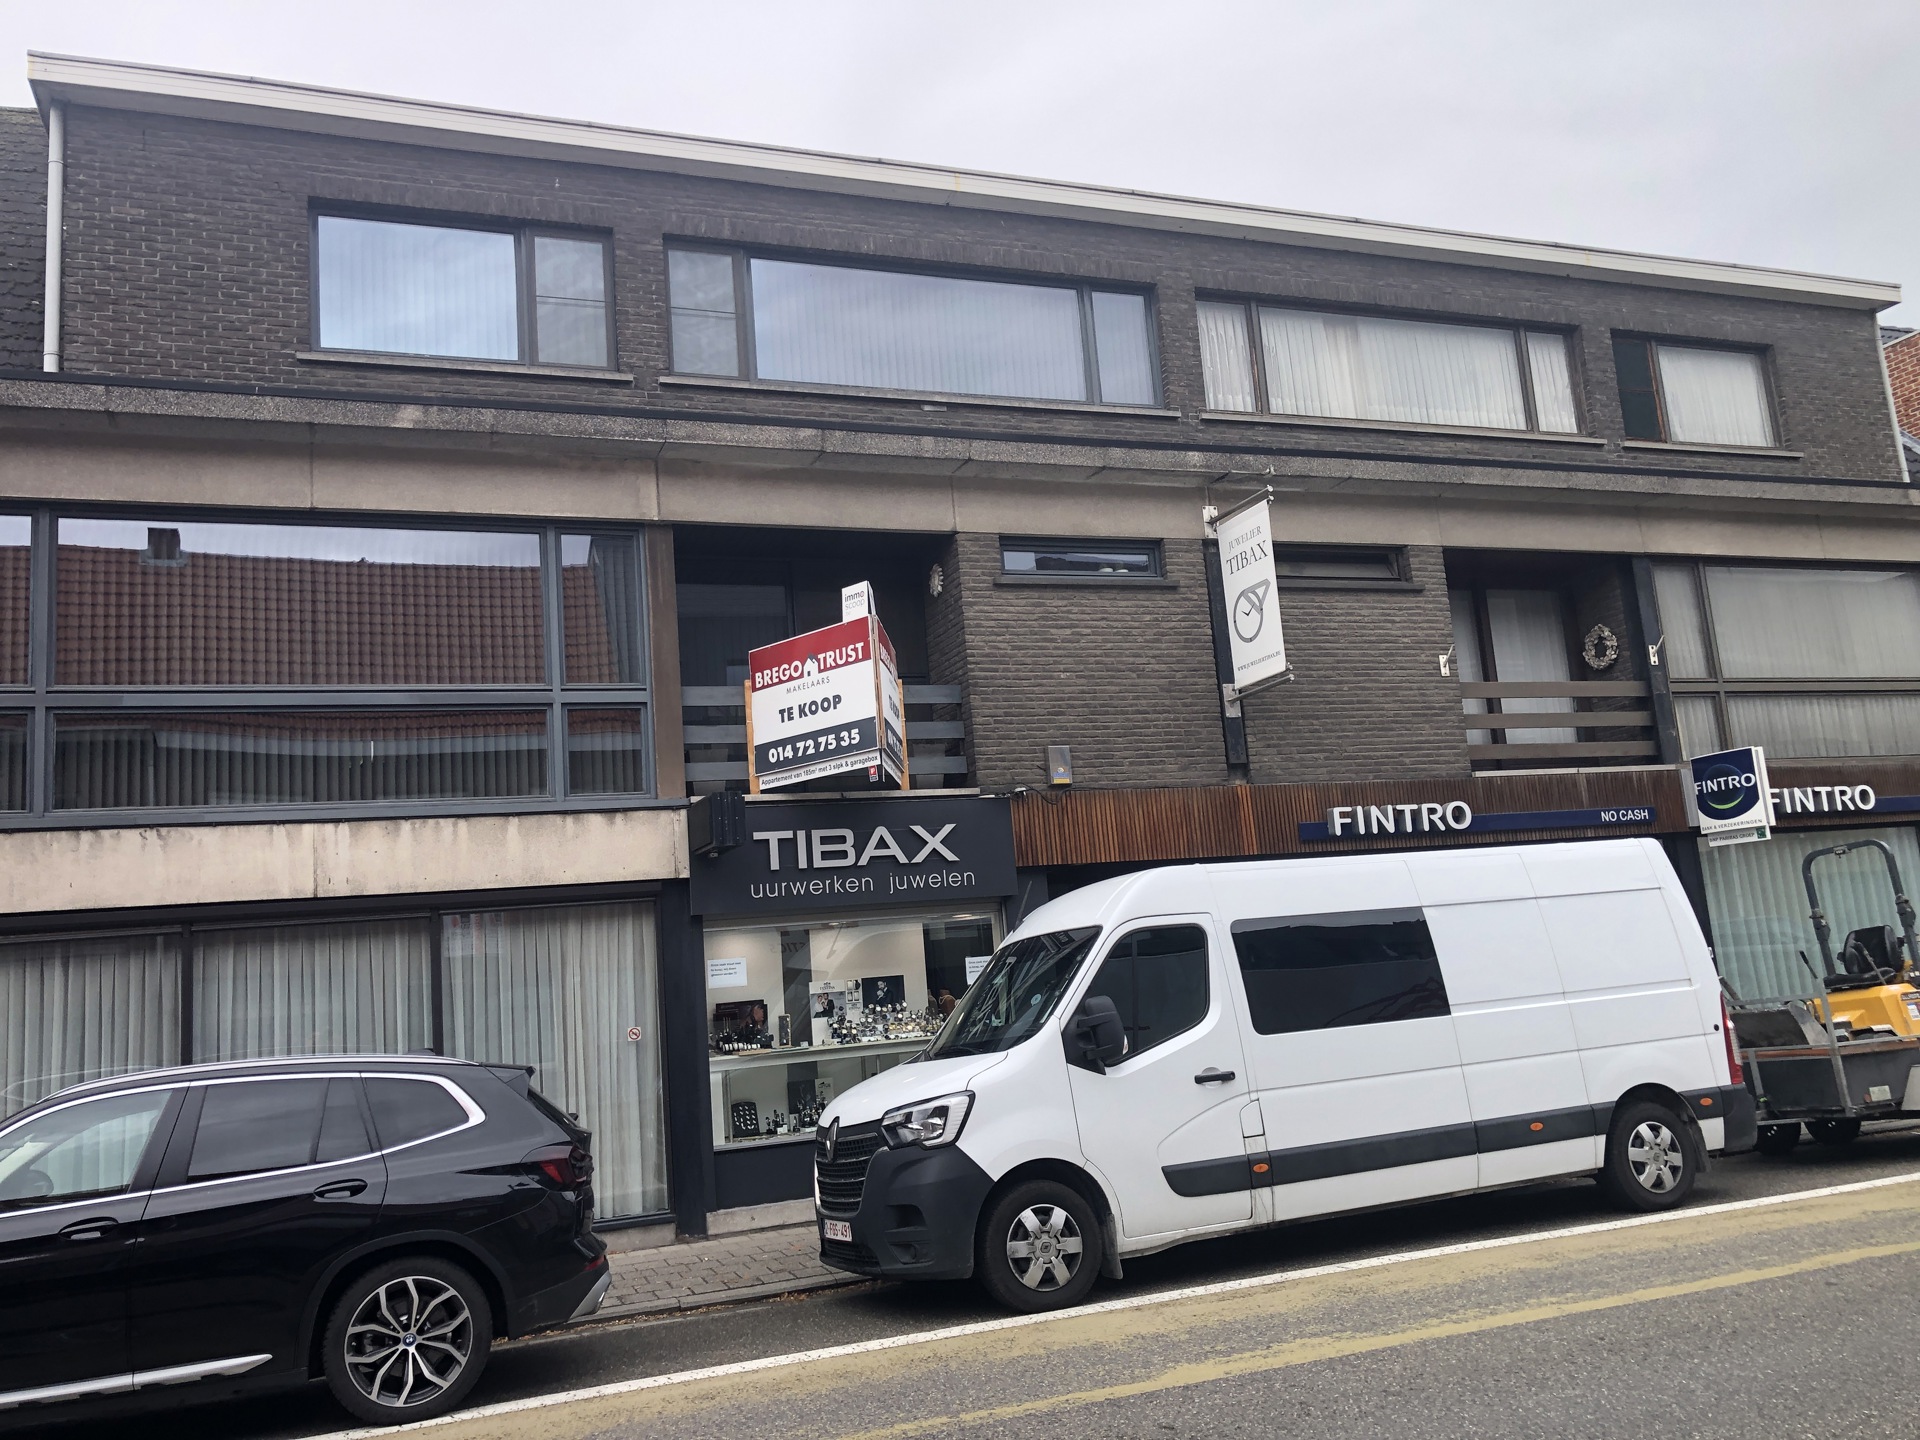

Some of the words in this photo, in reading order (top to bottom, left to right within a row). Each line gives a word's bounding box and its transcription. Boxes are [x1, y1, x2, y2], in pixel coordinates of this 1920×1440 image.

[1228, 526, 1262, 554] JUWELIER
[1226, 540, 1268, 575] TIBAX
[844, 590, 865, 602] immo
[845, 598, 865, 611] scoop
[755, 660, 802, 689] BREGO
[818, 642, 864, 670] TRUST
[786, 675, 831, 695] MAKELAARS
[779, 706, 795, 723] TE
[798, 694, 842, 719] KOOP
[768, 744, 794, 763] 014
[796, 739, 816, 757] 72
[818, 734, 837, 752] 75
[840, 728, 860, 747] 35
[761, 774, 793, 786] Appartement
[844, 760, 850, 768] &
[850, 756, 878, 767] garagebox
[1695, 773, 1756, 795] FINTRO
[1333, 800, 1472, 837] FINTRO
[1600, 810, 1618, 822] NO
[1619, 808, 1649, 821] CASH
[1718, 819, 1762, 829] VERZEKERINGEN
[753, 823, 960, 870] TIBAX
[750, 875, 874, 899] uurwerken
[889, 869, 976, 894] juwelen
